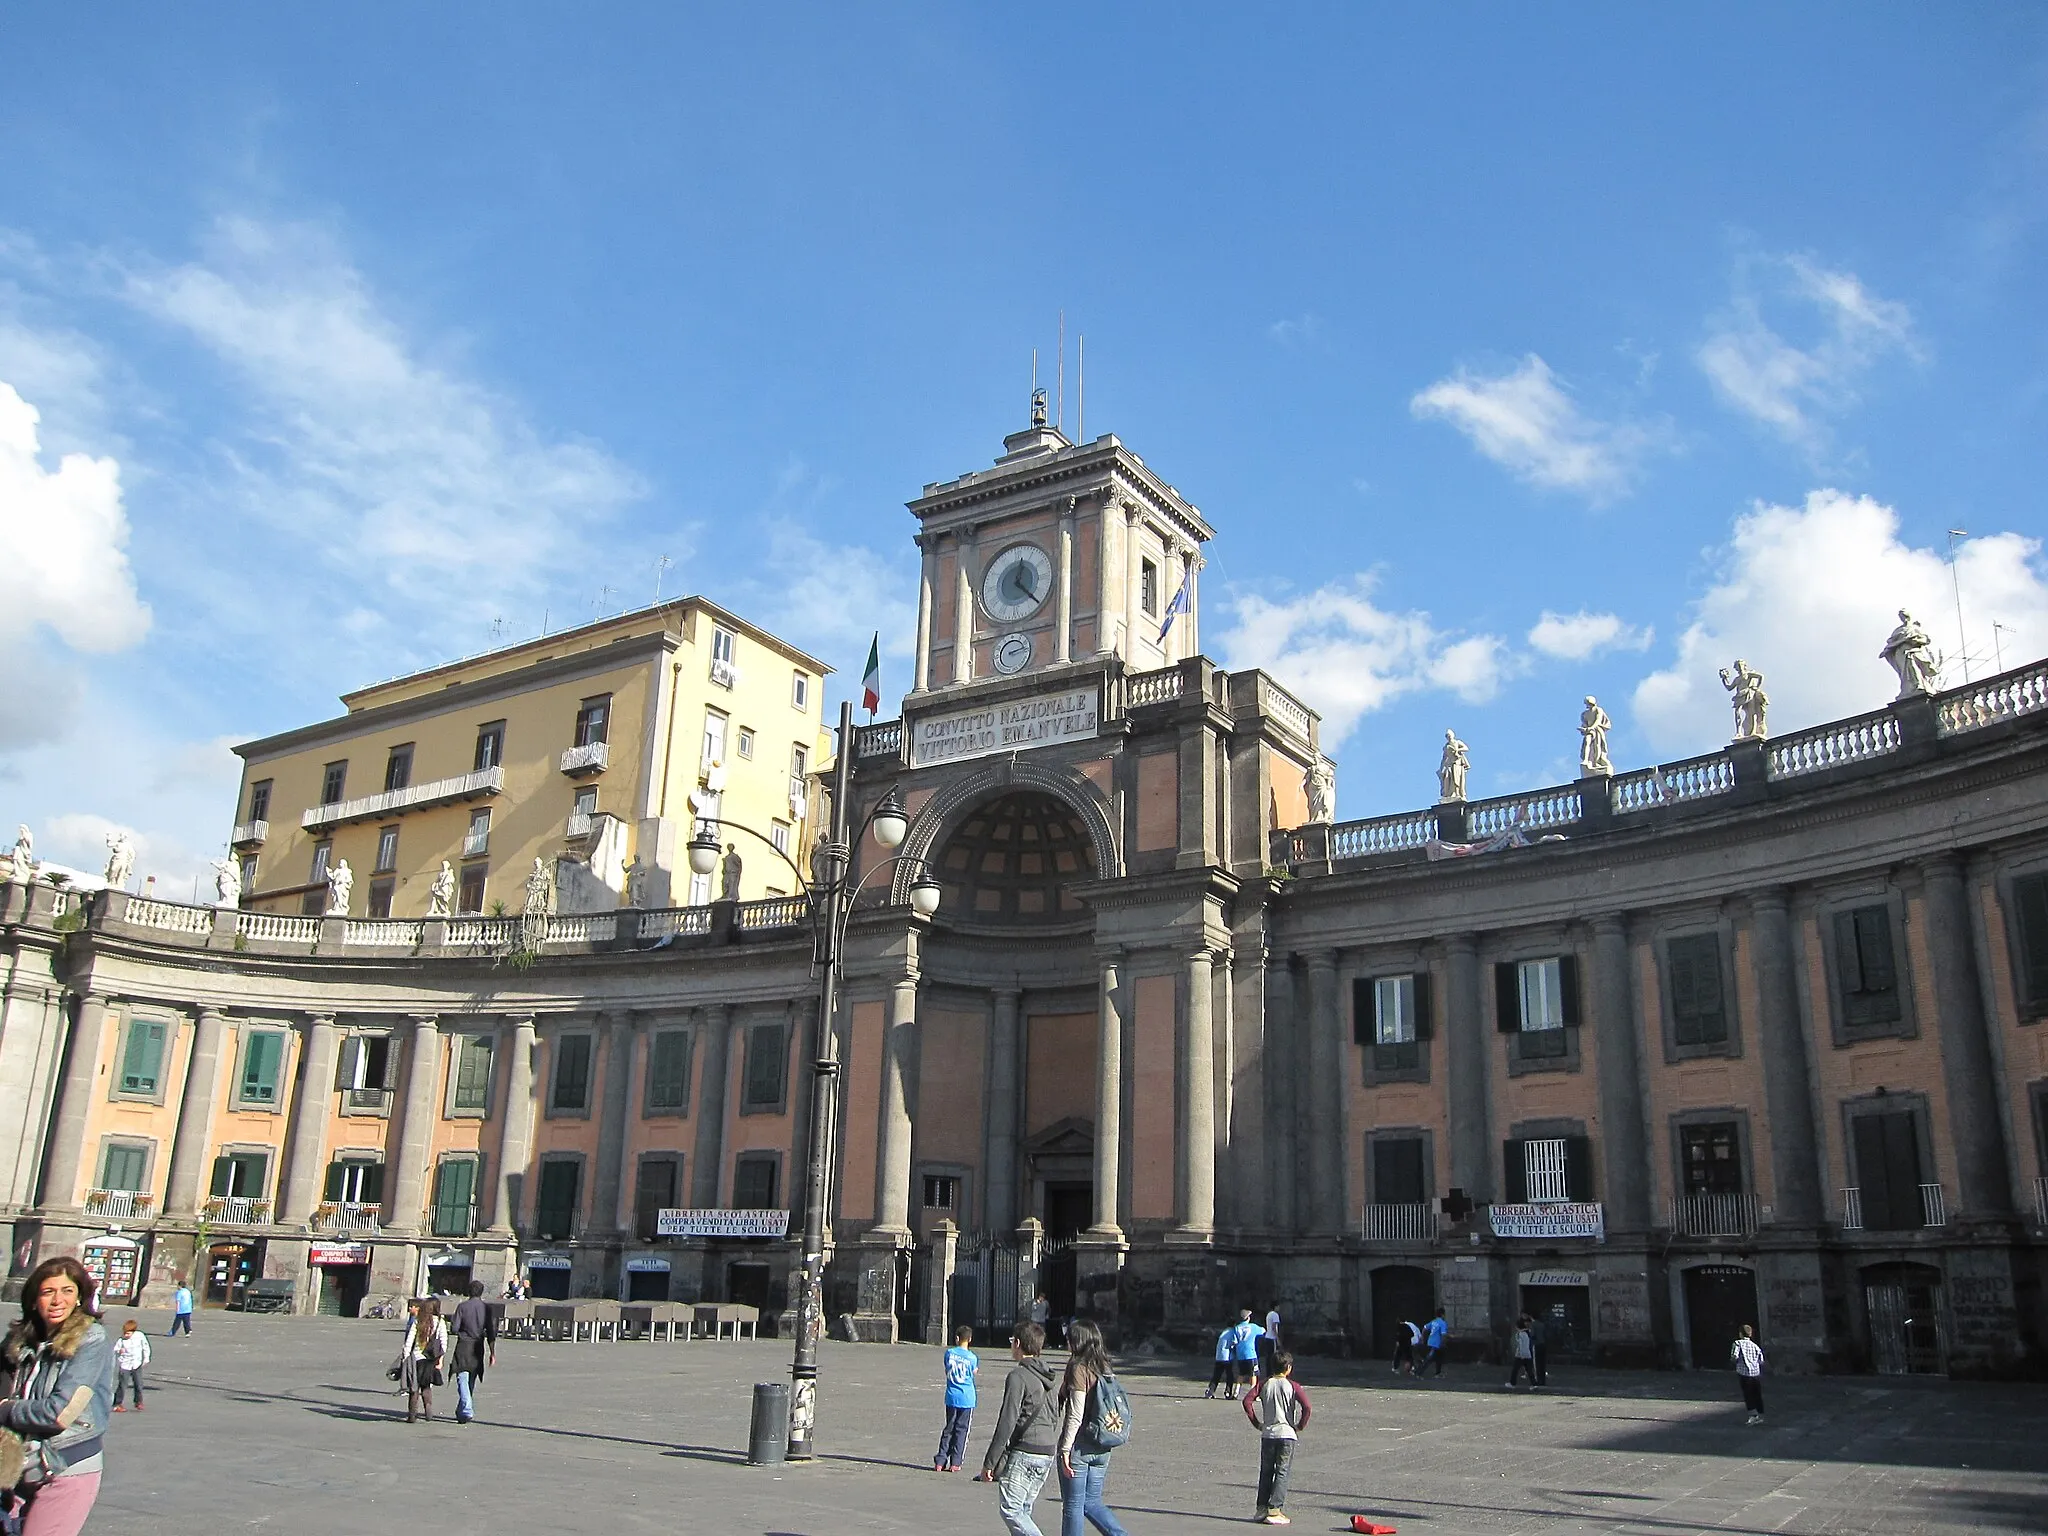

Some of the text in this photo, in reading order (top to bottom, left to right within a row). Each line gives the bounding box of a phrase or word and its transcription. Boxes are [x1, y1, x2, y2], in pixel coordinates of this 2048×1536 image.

[925, 694, 1086, 739] CONVITTO NAZIONALE
[918, 731, 996, 760] VITTORIO
[664, 1209, 783, 1219] LIBRERIA SCOLASTICA
[1492, 1204, 1598, 1216] LIBRERIA SCOLASTICA
[735, 1218, 758, 1226] LIBRI
[761, 1218, 786, 1226] USATI
[1575, 1214, 1598, 1223] USATI
[726, 1226, 738, 1234] LE
[741, 1226, 780, 1234] SCUOLE
[1497, 1224, 1593, 1234] PER TUTTE LE SCUOLE
[1529, 1272, 1582, 1283] Libreria
